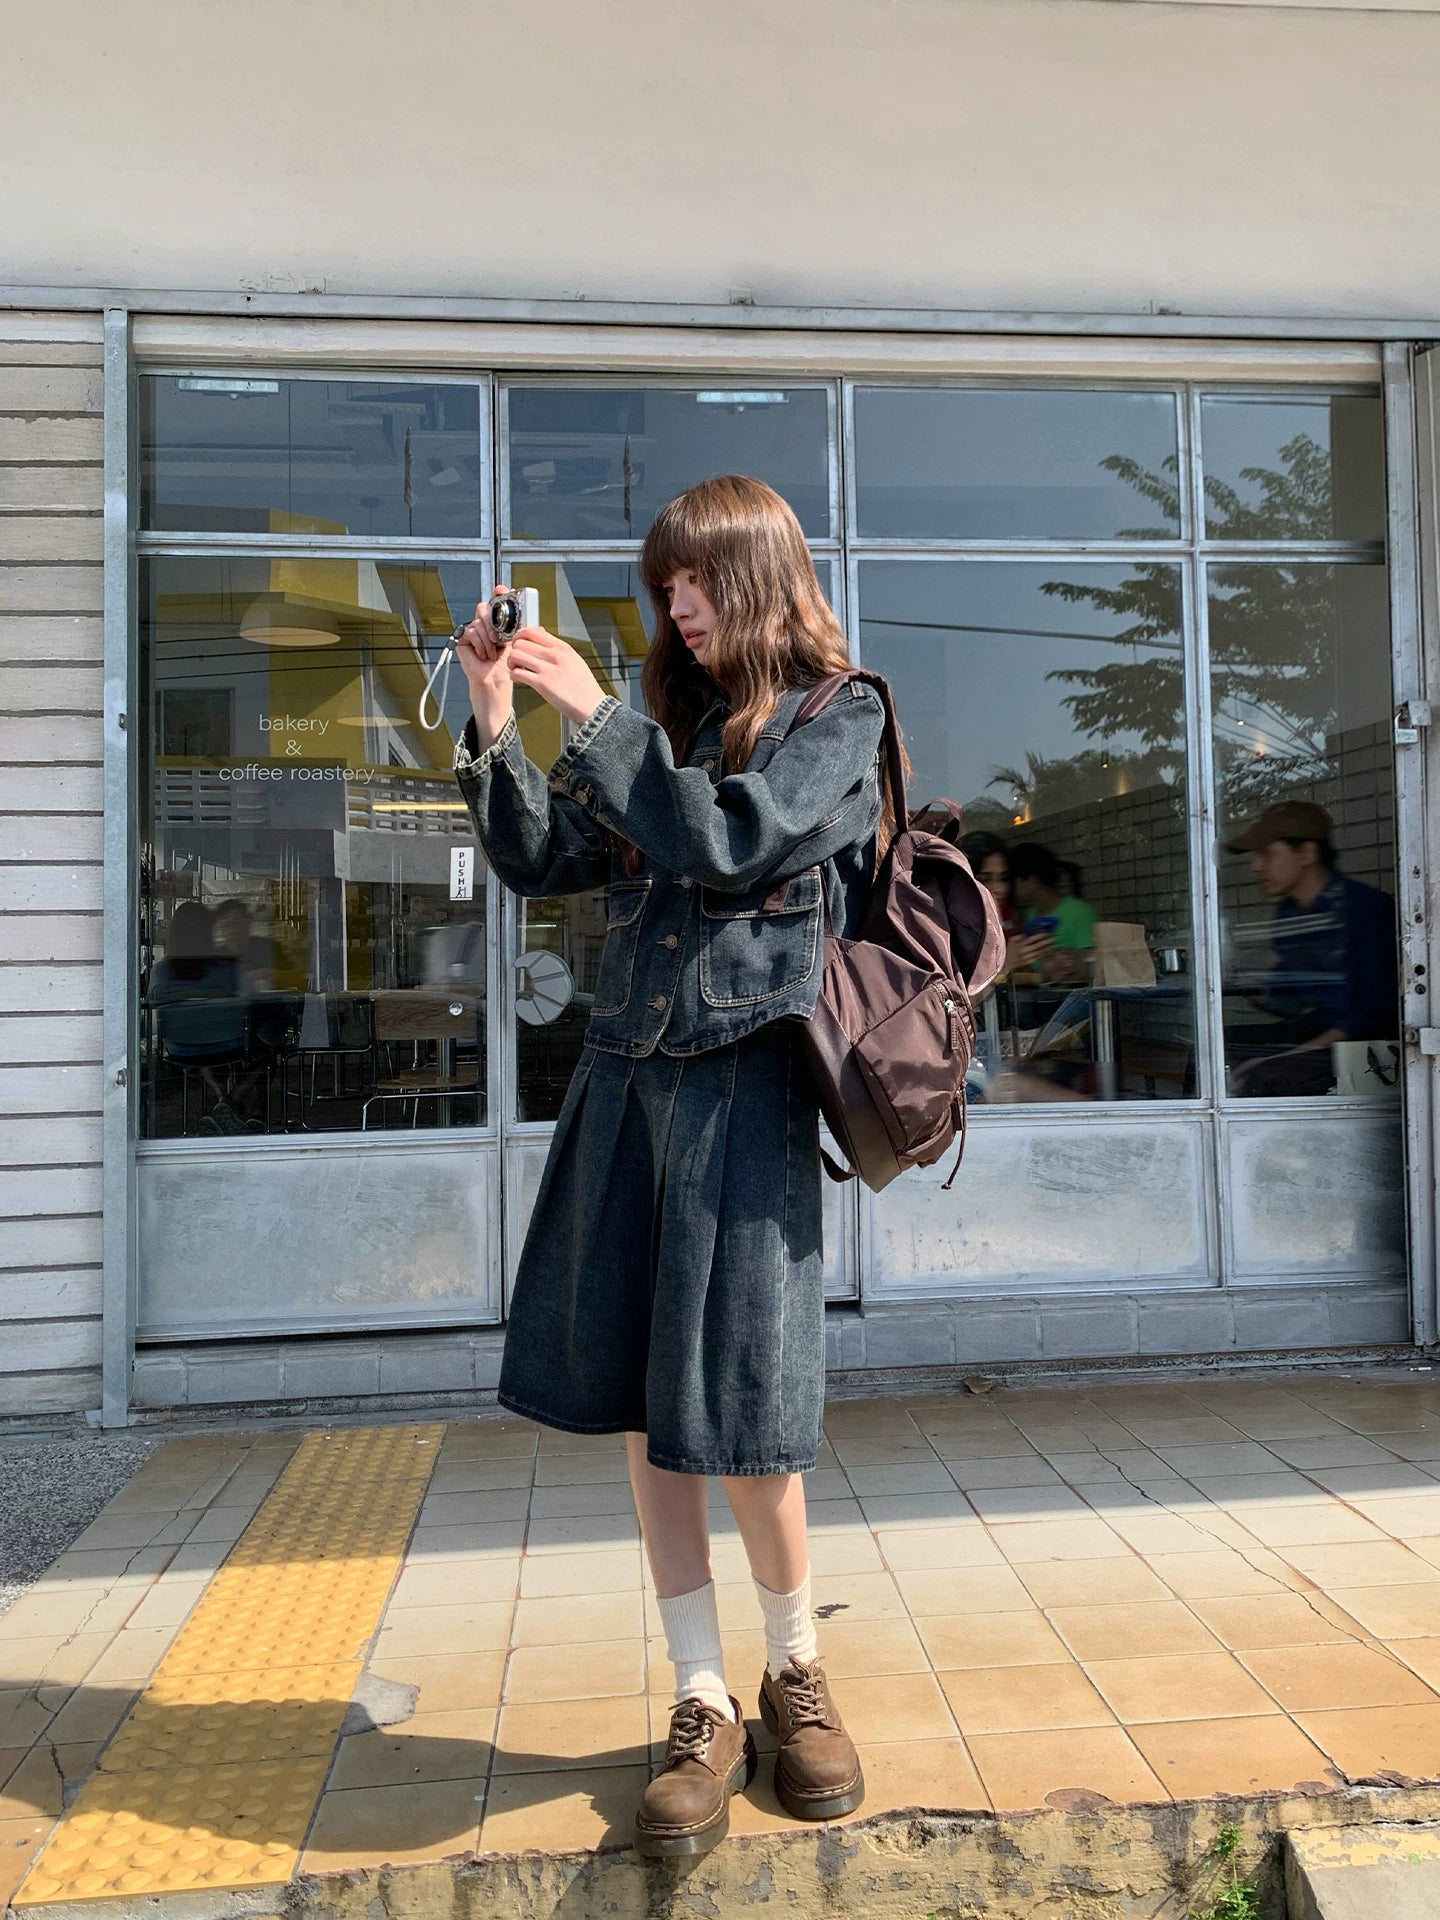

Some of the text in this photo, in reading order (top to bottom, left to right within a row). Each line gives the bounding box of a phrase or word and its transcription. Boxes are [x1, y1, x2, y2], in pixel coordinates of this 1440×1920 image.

[259, 714, 329, 735] bakery
[285, 739, 302, 756] &
[219, 763, 375, 784] coffee roastery
[457, 851, 466, 885] PUSH
